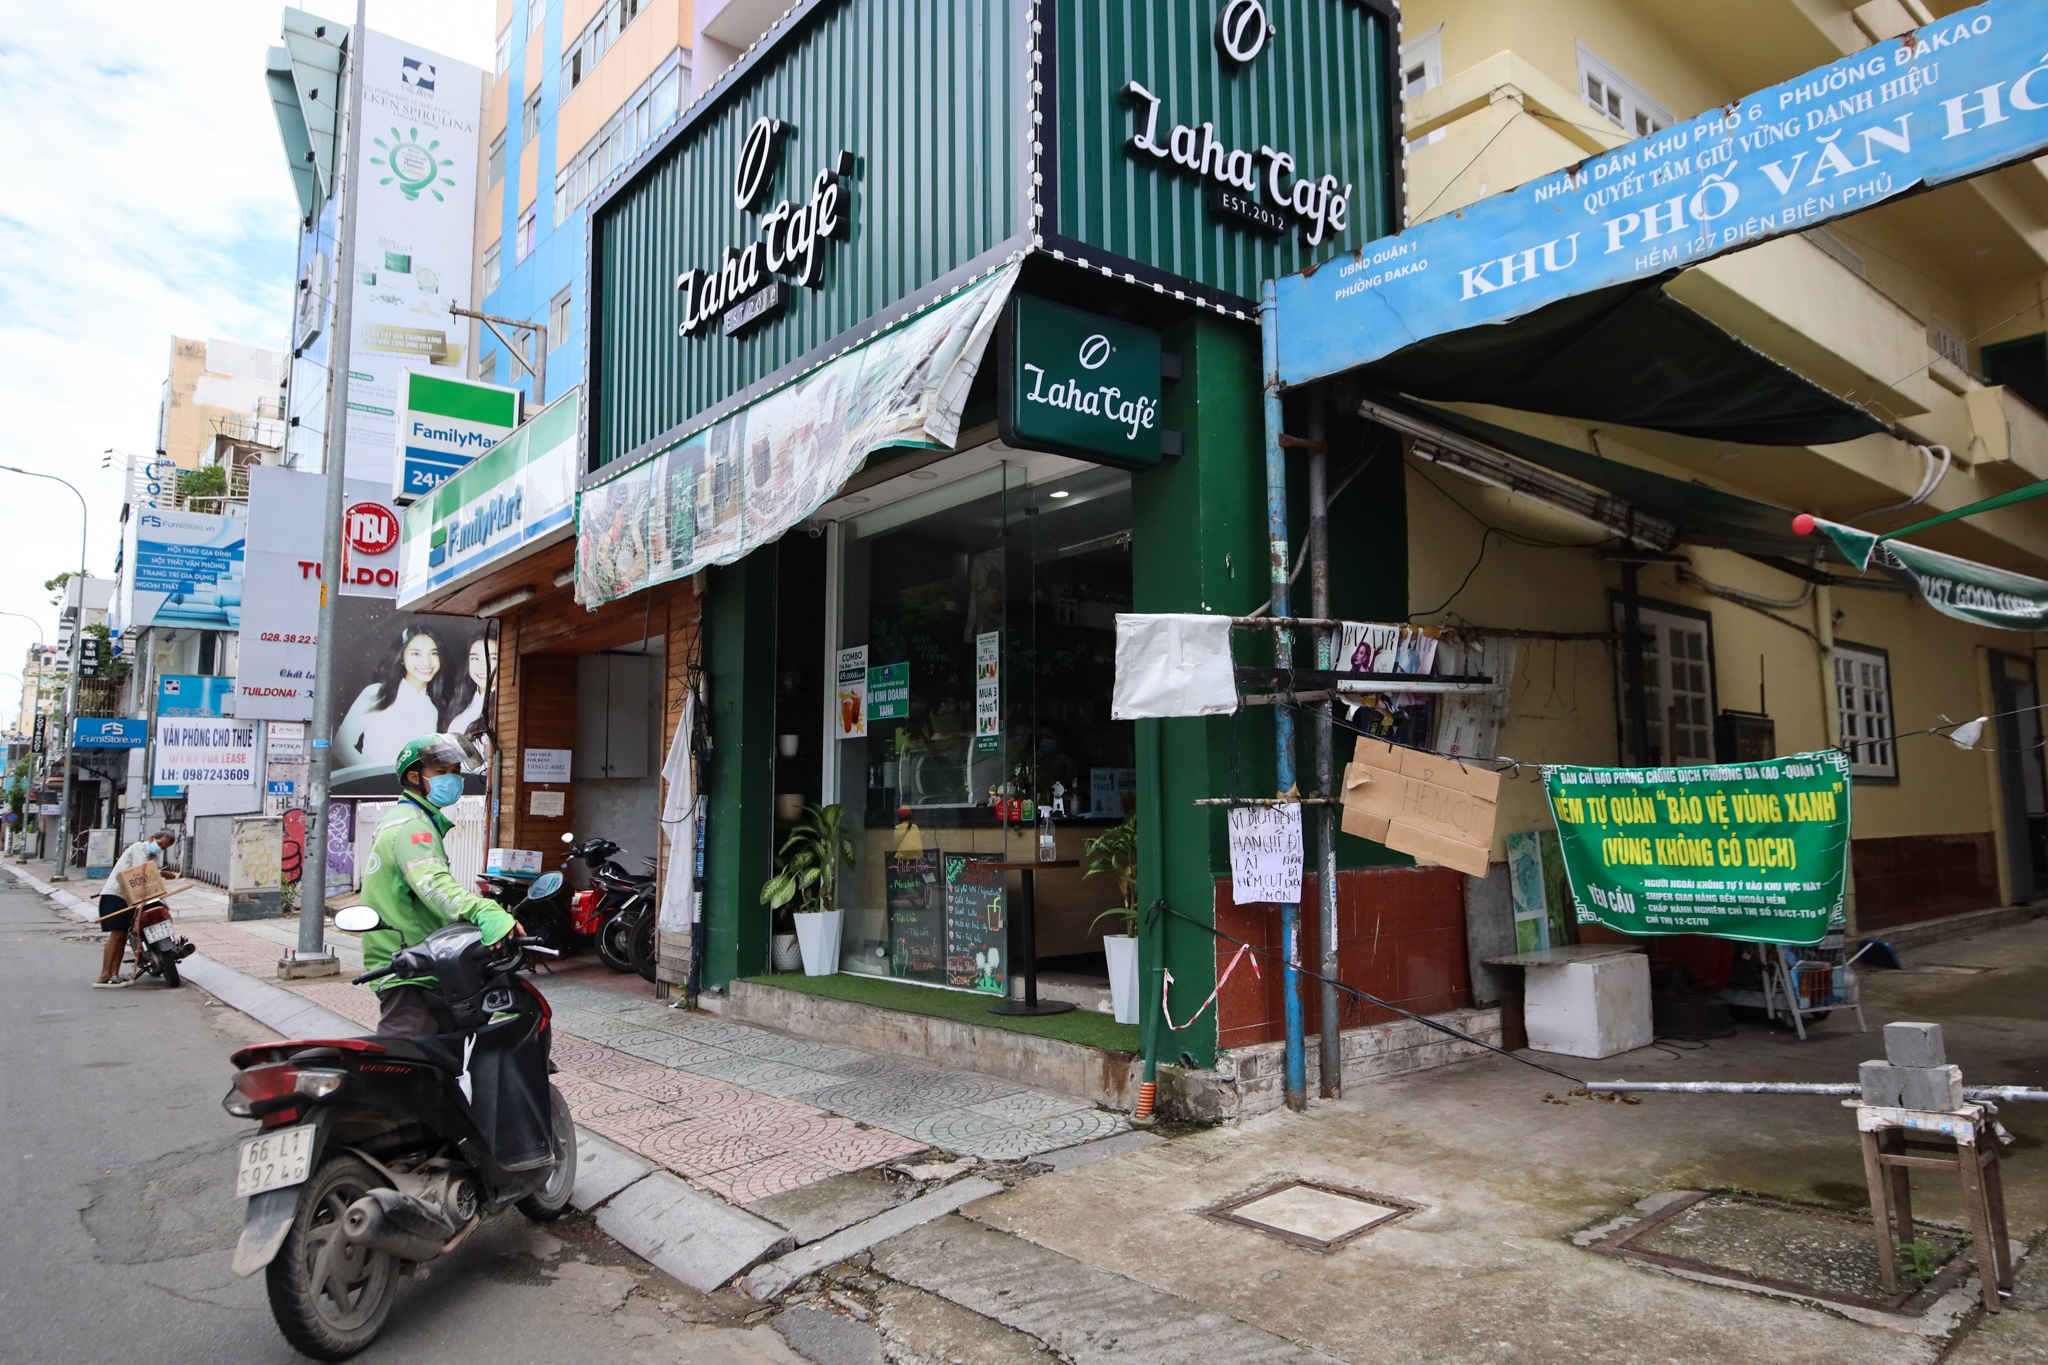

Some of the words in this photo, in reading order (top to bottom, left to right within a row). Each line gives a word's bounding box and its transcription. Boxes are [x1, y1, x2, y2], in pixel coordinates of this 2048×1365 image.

[403, 105, 472, 134] SPIRULINA
[1535, 168, 1588, 203] NHÂN
[1594, 152, 1637, 181] DÂN
[1643, 131, 1688, 162] KHU
[1748, 104, 1763, 121] 6
[1779, 57, 1885, 110] PHƯỜNG
[1893, 14, 1992, 66] ĐAKAO
[1584, 171, 1645, 215] QUYẾT
[1649, 156, 1690, 188] TÂM
[1696, 137, 1733, 170] GIỮ
[1739, 117, 1800, 153] VỮNG
[1805, 89, 1874, 131] DANH
[1880, 63, 1940, 104] HIỆU
[1129, 80, 1256, 192] Laha
[1261, 145, 1352, 246] Café
[1222, 193, 1285, 230] EST.2012
[1458, 231, 1581, 302] KHU
[1603, 159, 1740, 255] PHỐ
[1758, 112, 1914, 195] VĂN
[1635, 246, 1678, 271] HẺM
[1685, 233, 1716, 256] 127
[1782, 195, 1835, 225] BIÊN
[1843, 171, 1893, 204] PHỦ
[677, 243, 759, 337] Laha
[761, 150, 846, 287] Café
[1339, 257, 1370, 278] UBND
[1372, 248, 1408, 269] QUẬN
[1334, 275, 1382, 301] PHƯỜNG
[1384, 259, 1429, 282] ĐAKAO
[726, 288, 777, 330] EST.2012
[1024, 363, 1100, 416] Laha
[1099, 386, 1157, 440] Café
[413, 422, 502, 449] FamilyMar
[141, 515, 161, 528] FS
[162, 520, 215, 532] FurniStore.vn
[448, 485, 523, 557] FamilyMart
[201, 549, 214, 557] GIA
[142, 570, 167, 578] TRANG
[1920, 575, 1953, 605] JUST
[1955, 582, 1996, 611] GOOD
[283, 634, 296, 643] 38
[298, 635, 311, 644] 22
[842, 651, 863, 662] COMBO
[242, 686, 296, 698] TUILDONAI
[875, 690, 887, 703] KINH
[888, 688, 908, 700] DOANH
[979, 688, 992, 699] MUA
[879, 704, 894, 717] XANH
[80, 735, 141, 744] FurniStore.vn
[102, 722, 123, 735] FS
[164, 724, 180, 747] VĂN
[182, 723, 210, 747] PHÒNG
[212, 729, 229, 748] CHO
[232, 724, 253, 748] THUÊ
[202, 754, 219, 764] FOR
[221, 754, 246, 764] LEASE
[162, 769, 179, 781] LH:
[182, 769, 250, 781] 0987243609
[1560, 772, 1577, 784] BAN
[1595, 772, 1612, 787] ĐẠO
[1677, 768, 1701, 785] DỊCH
[1744, 766, 1760, 780] ĐA
[1761, 766, 1780, 780] KAO
[1553, 789, 1585, 824] HẺM
[1586, 795, 1608, 830] TỰ
[1610, 788, 1657, 827] QUẢN
[1704, 789, 1730, 830] VỆ
[1731, 788, 1783, 823] VÙNG
[1233, 835, 1262, 855] HẠN
[1602, 832, 1653, 867] (VÙNG
[1655, 833, 1714, 867] KHÔNG
[1718, 833, 1745, 867] CÓ
[1747, 837, 1796, 874] DỊCH)
[415, 874, 462, 920] Grab
[1644, 879, 1669, 888] NGƯỜI
[1670, 880, 1695, 889] NGOÀI
[1697, 880, 1724, 889] KHÔNG
[1725, 881, 1737, 892] TỰ
[1745, 881, 1763, 891] VÀO
[1764, 882, 1782, 891] KHU
[1783, 882, 1801, 893] VỰC
[1802, 881, 1822, 891] NÀY
[1645, 892, 1673, 901] SHIPER
[1674, 893, 1694, 902] GIAO
[1695, 893, 1718, 903] HÀNG
[1719, 893, 1736, 903] BÊN
[1738, 894, 1765, 904] NGOÀI
[1608, 885, 1636, 914] CẦU
[1670, 905, 1693, 914] HÀNH
[1694, 905, 1726, 915] NGHIÊM
[1744, 907, 1758, 918] THỊ
[1759, 906, 1772, 917] SỐ
[1773, 908, 1816, 919] 16/CT-TTg
[1660, 916, 1673, 927] THỊ
[1674, 917, 1710, 926] 12-CT/TU
